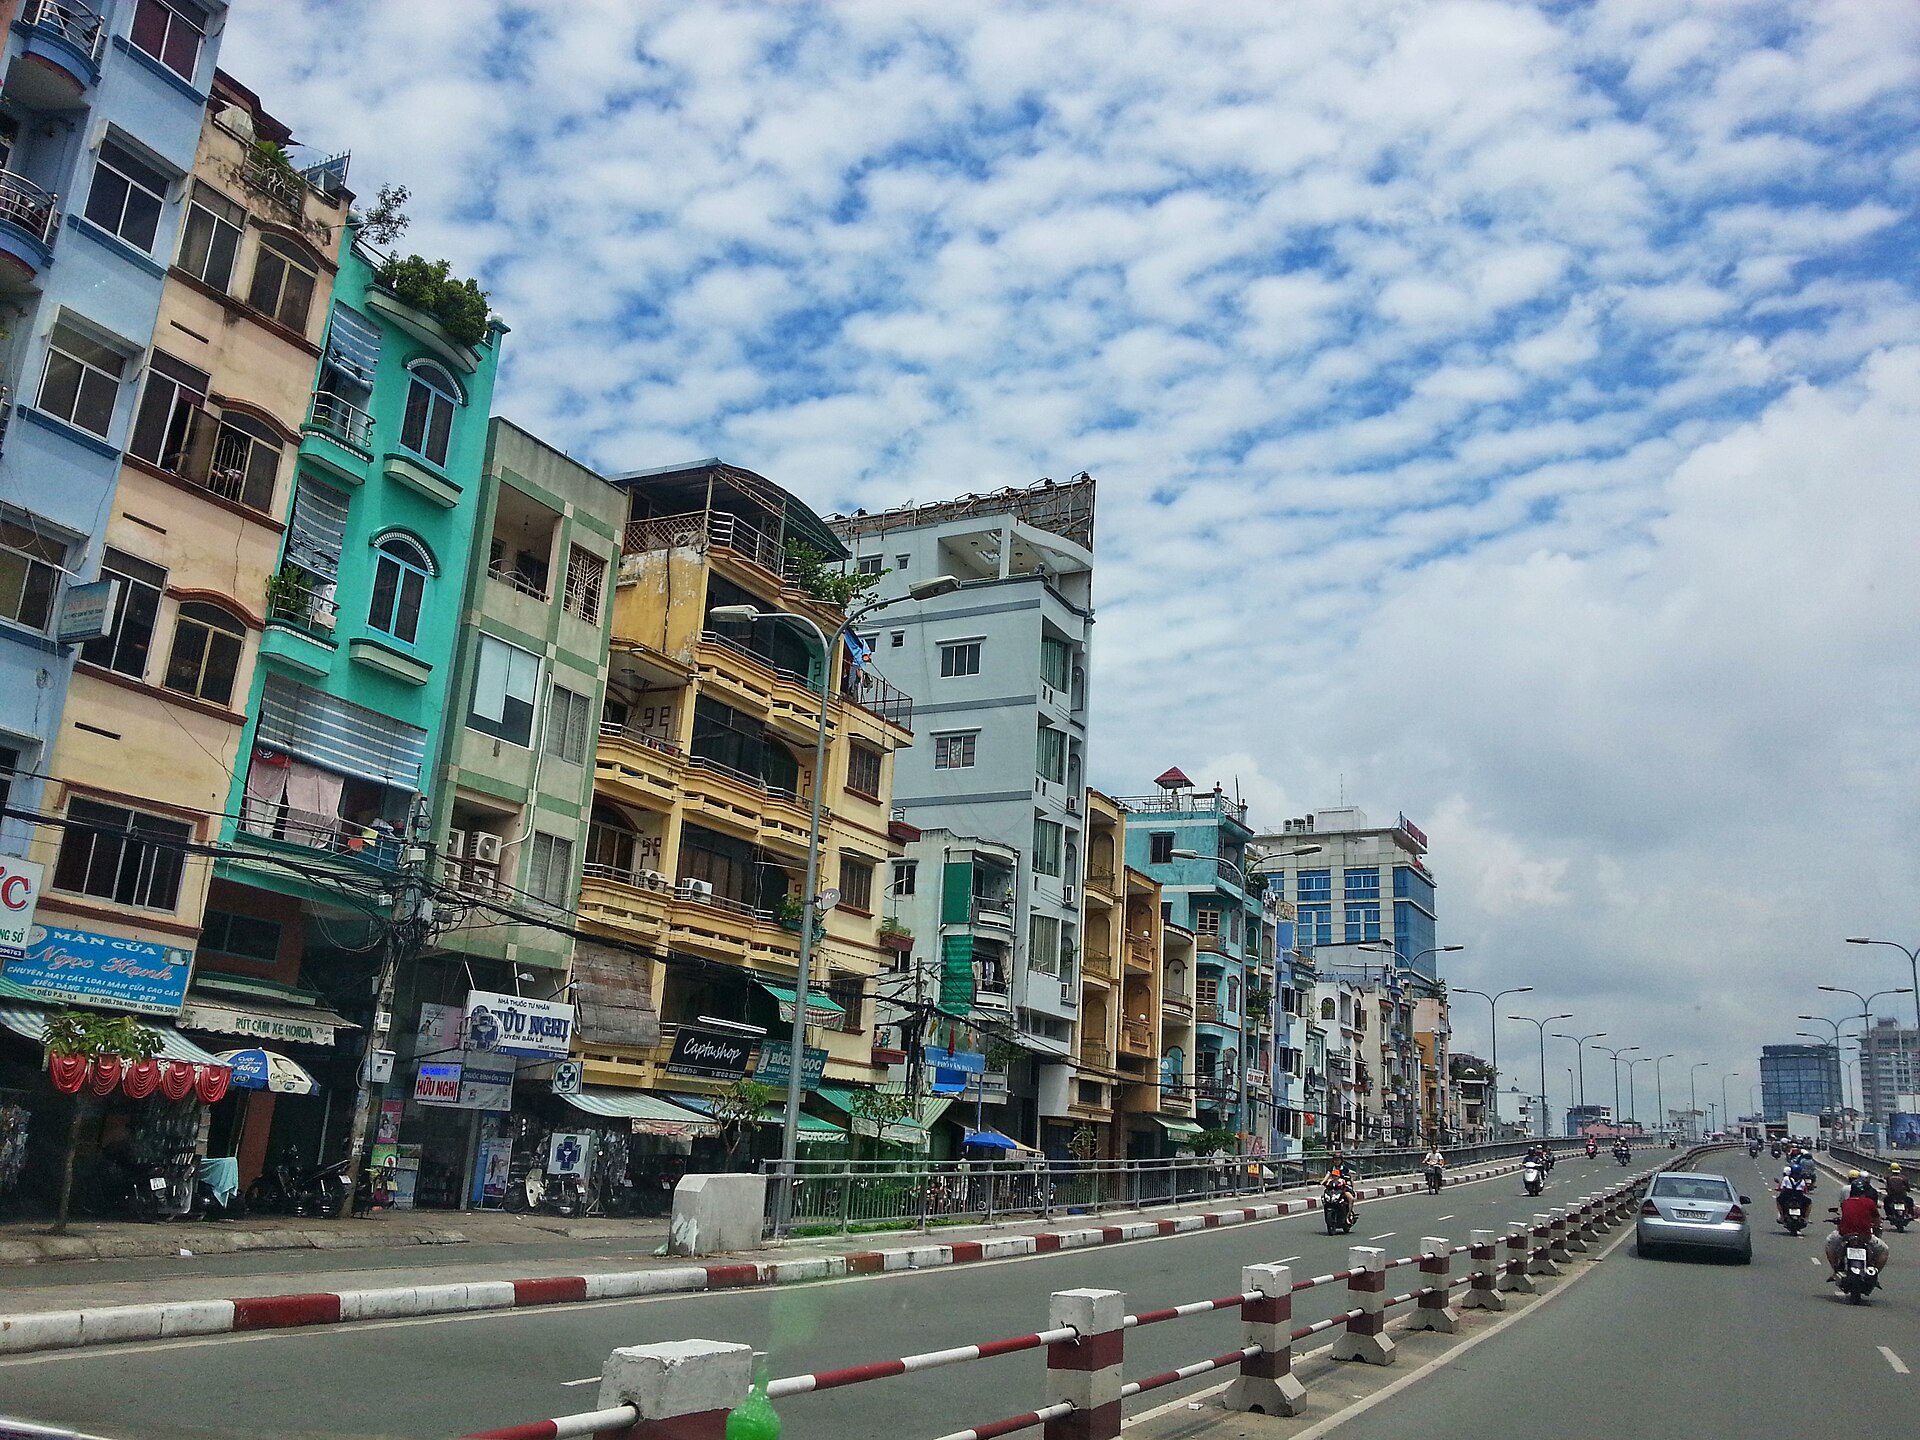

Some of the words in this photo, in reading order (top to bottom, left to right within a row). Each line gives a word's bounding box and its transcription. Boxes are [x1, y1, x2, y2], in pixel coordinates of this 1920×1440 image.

[0, 866, 31, 912] C
[54, 931, 105, 946] MÀN
[111, 941, 156, 955] CỬA
[25, 945, 94, 970] Ngọc
[101, 957, 173, 980] Hạnh
[45, 972, 66, 981] MAY
[147, 986, 162, 995] CAO
[272, 1022, 284, 1035] XE
[286, 1025, 313, 1039] HONDA
[501, 1033, 520, 1041] UYÊN
[528, 1015, 570, 1043] NGHỊ
[802, 1057, 822, 1072] GỌC
[416, 1076, 436, 1096] HỮU
[436, 1081, 458, 1100] NGHỊ
